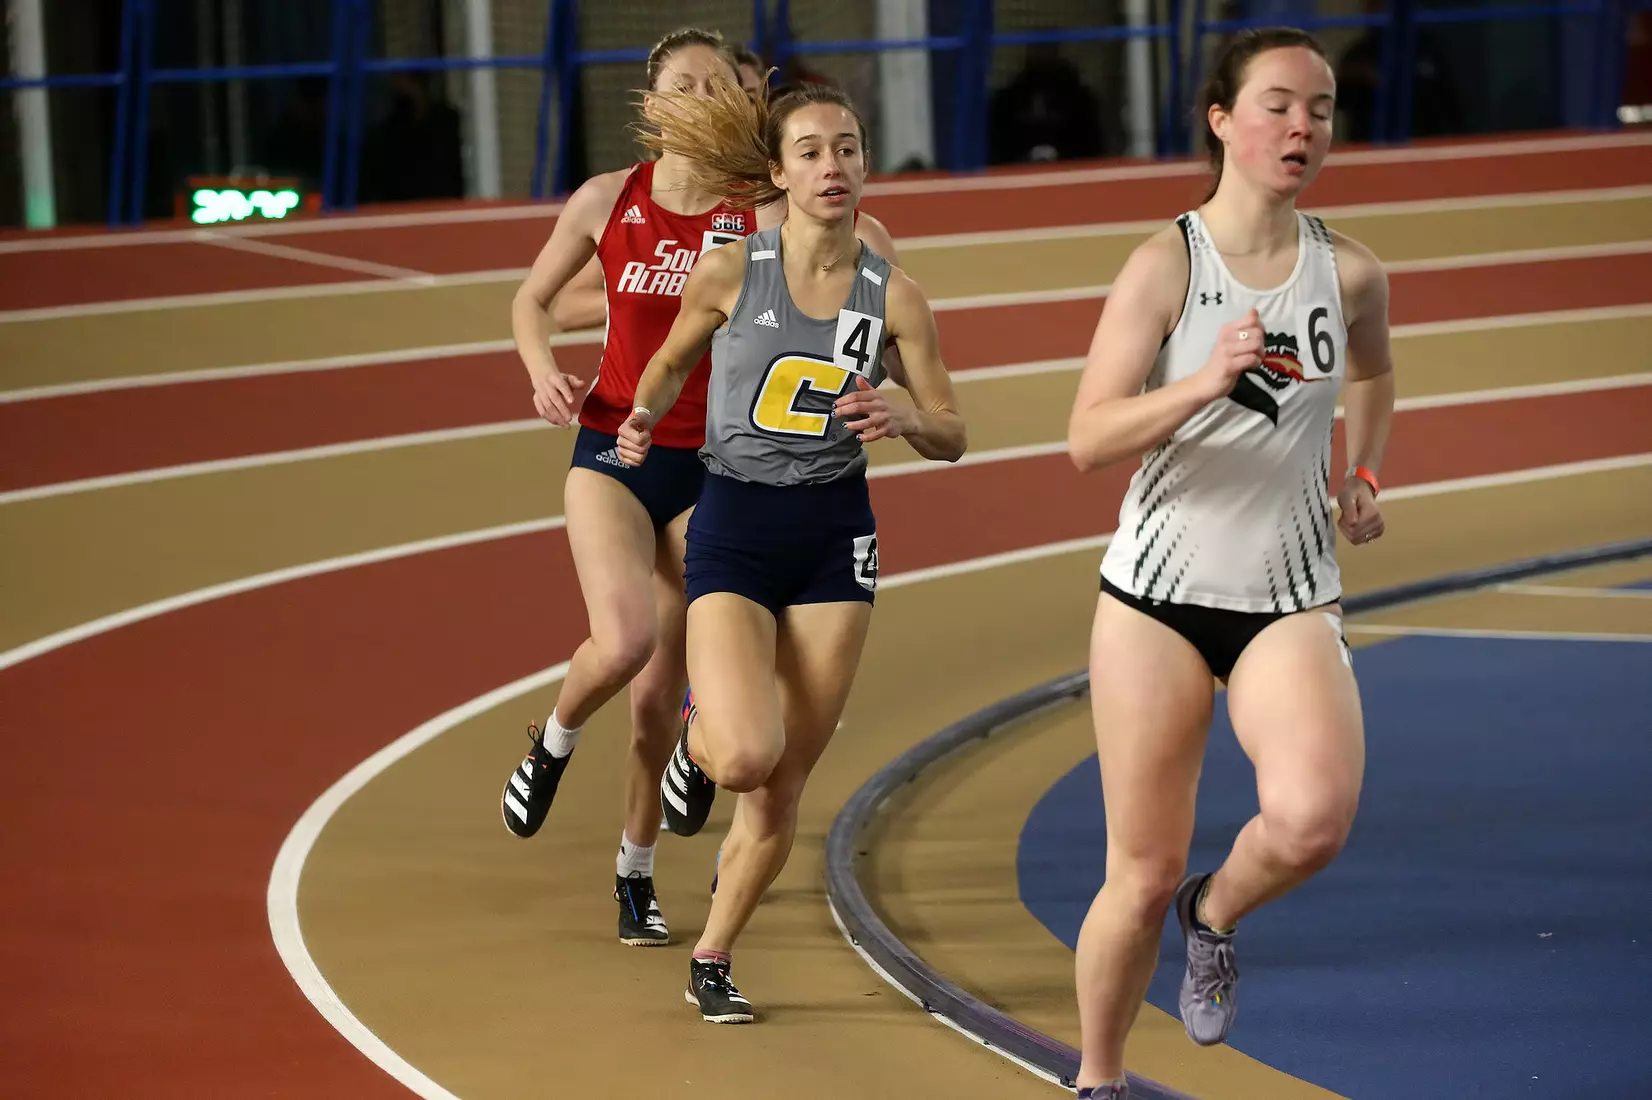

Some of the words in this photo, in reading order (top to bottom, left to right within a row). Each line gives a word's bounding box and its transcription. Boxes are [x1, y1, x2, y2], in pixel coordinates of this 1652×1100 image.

[620, 216, 646, 225] adidas
[712, 213, 746, 232] SBC
[753, 318, 780, 330] adidas
[1307, 306, 1336, 374] 6
[841, 317, 872, 372] 4
[748, 351, 852, 440] C
